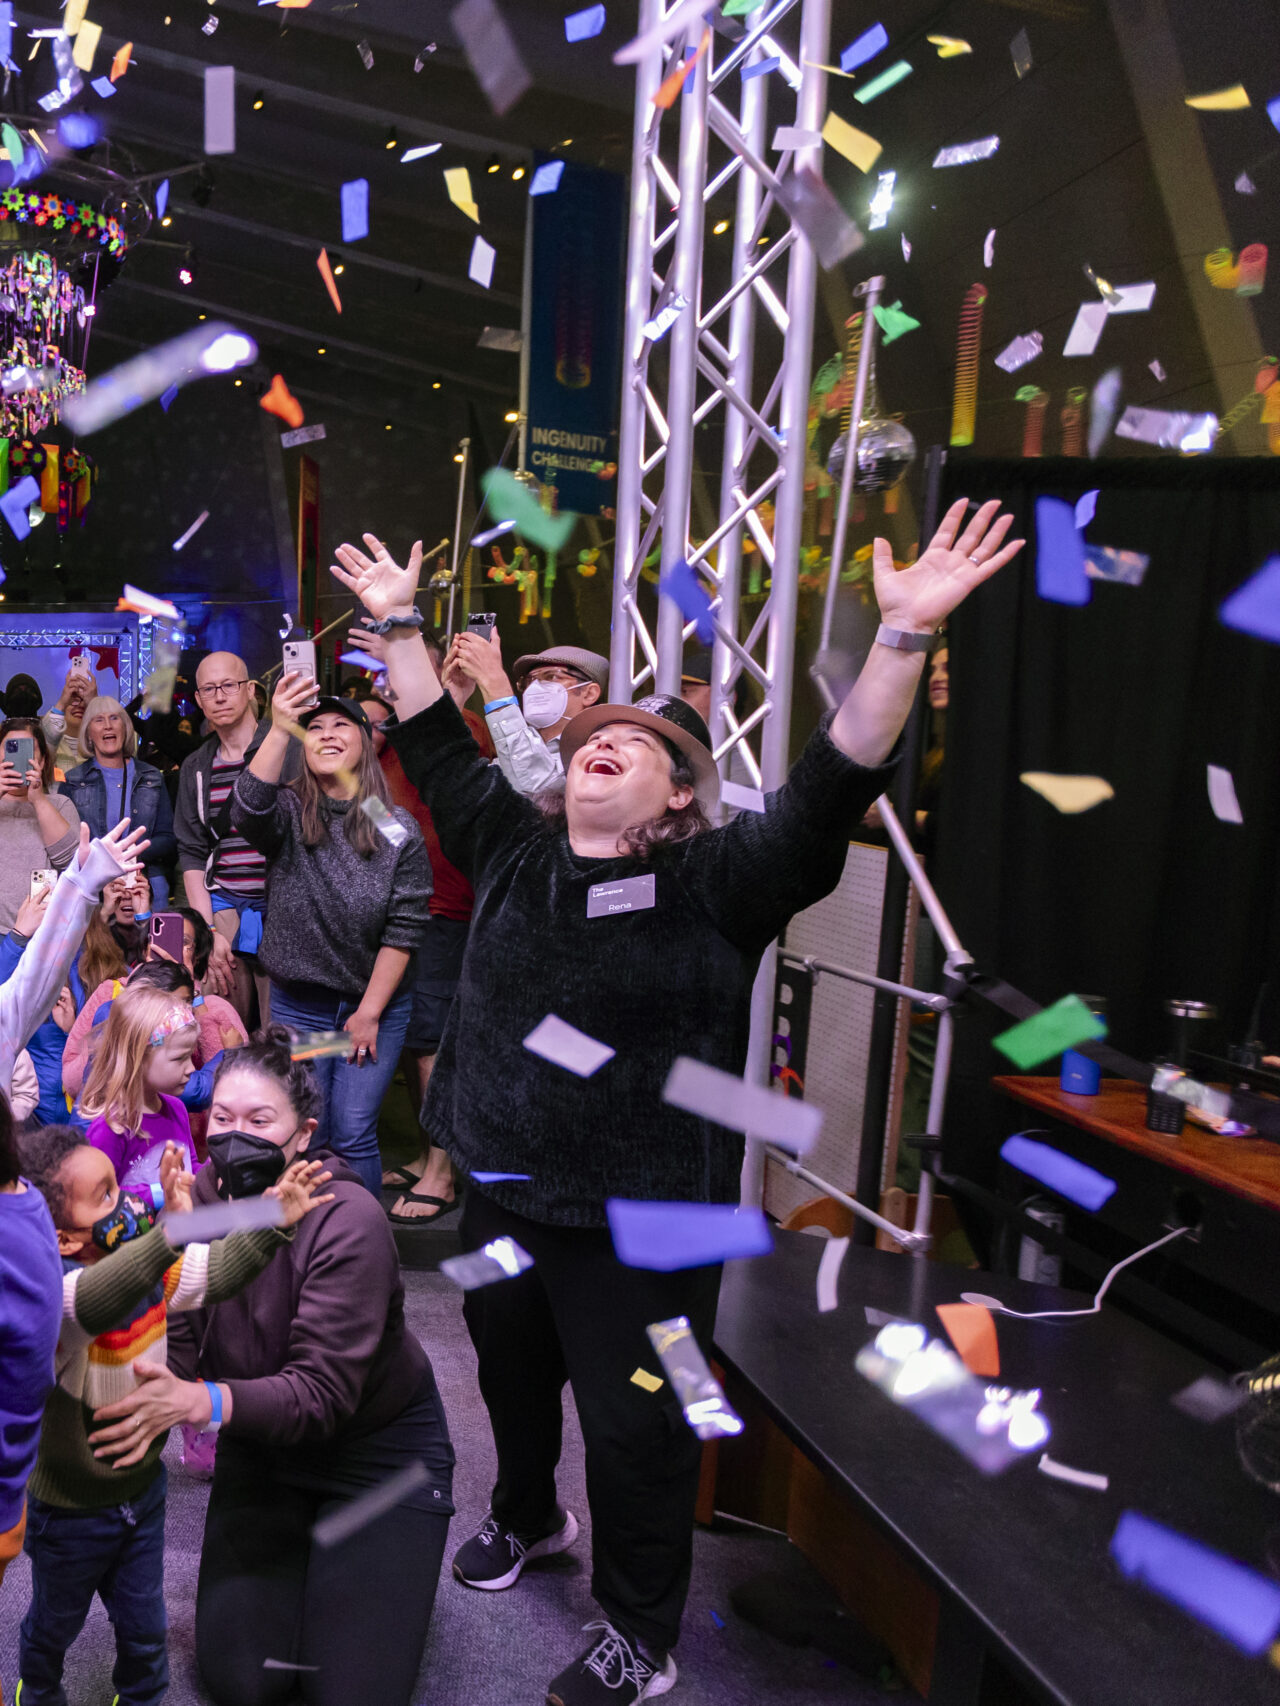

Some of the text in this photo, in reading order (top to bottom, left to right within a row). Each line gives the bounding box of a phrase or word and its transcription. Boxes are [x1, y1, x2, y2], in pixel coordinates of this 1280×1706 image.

[532, 426, 607, 453] INGENUITY
[531, 450, 596, 473] CHALLENG
[608, 903, 632, 912] Rena
